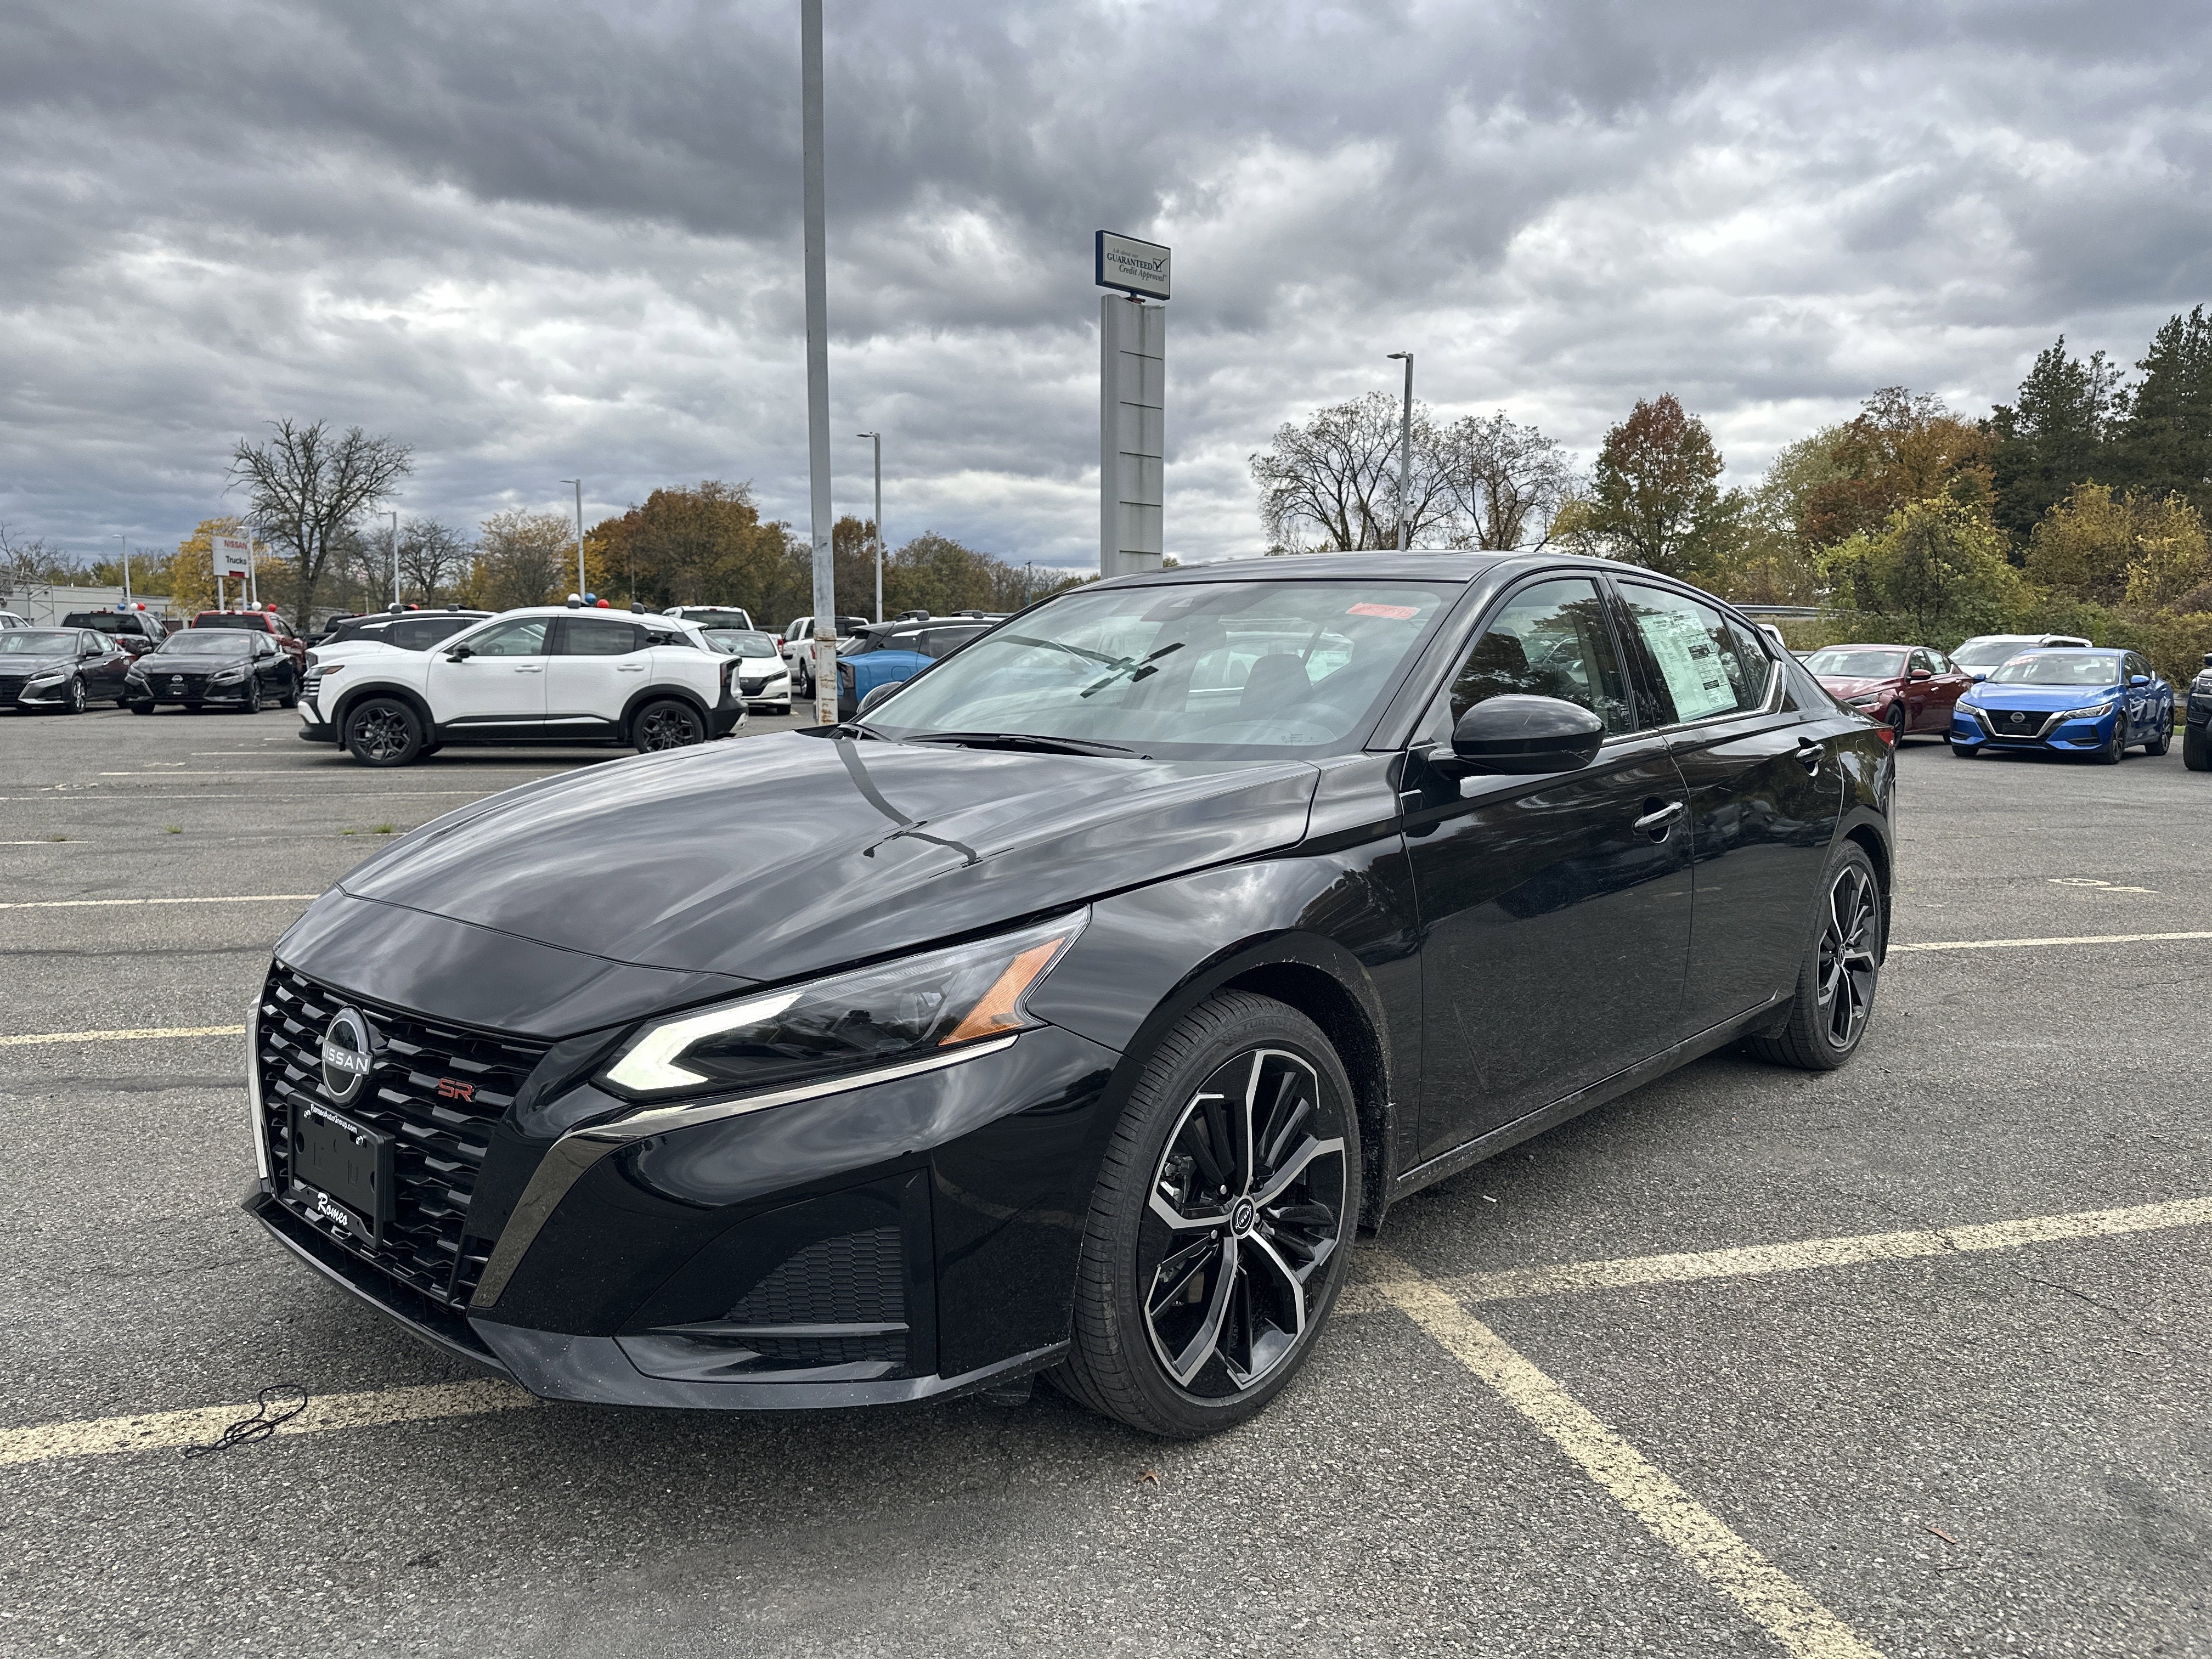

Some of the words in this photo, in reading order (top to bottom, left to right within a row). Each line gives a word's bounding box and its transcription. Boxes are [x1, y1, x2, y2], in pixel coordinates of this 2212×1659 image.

[1107, 252, 1153, 270] GUARANTEED
[1119, 264, 1137, 275] Credit
[1138, 269, 1165, 282] Approval
[224, 540, 247, 550] NISSAN
[225, 555, 247, 565] Trucks
[322, 1042, 369, 1073] NISSAN
[438, 1077, 473, 1102] SR
[311, 1103, 358, 1134] RomeoAutoGroup.com
[318, 1192, 348, 1226] Romeo
